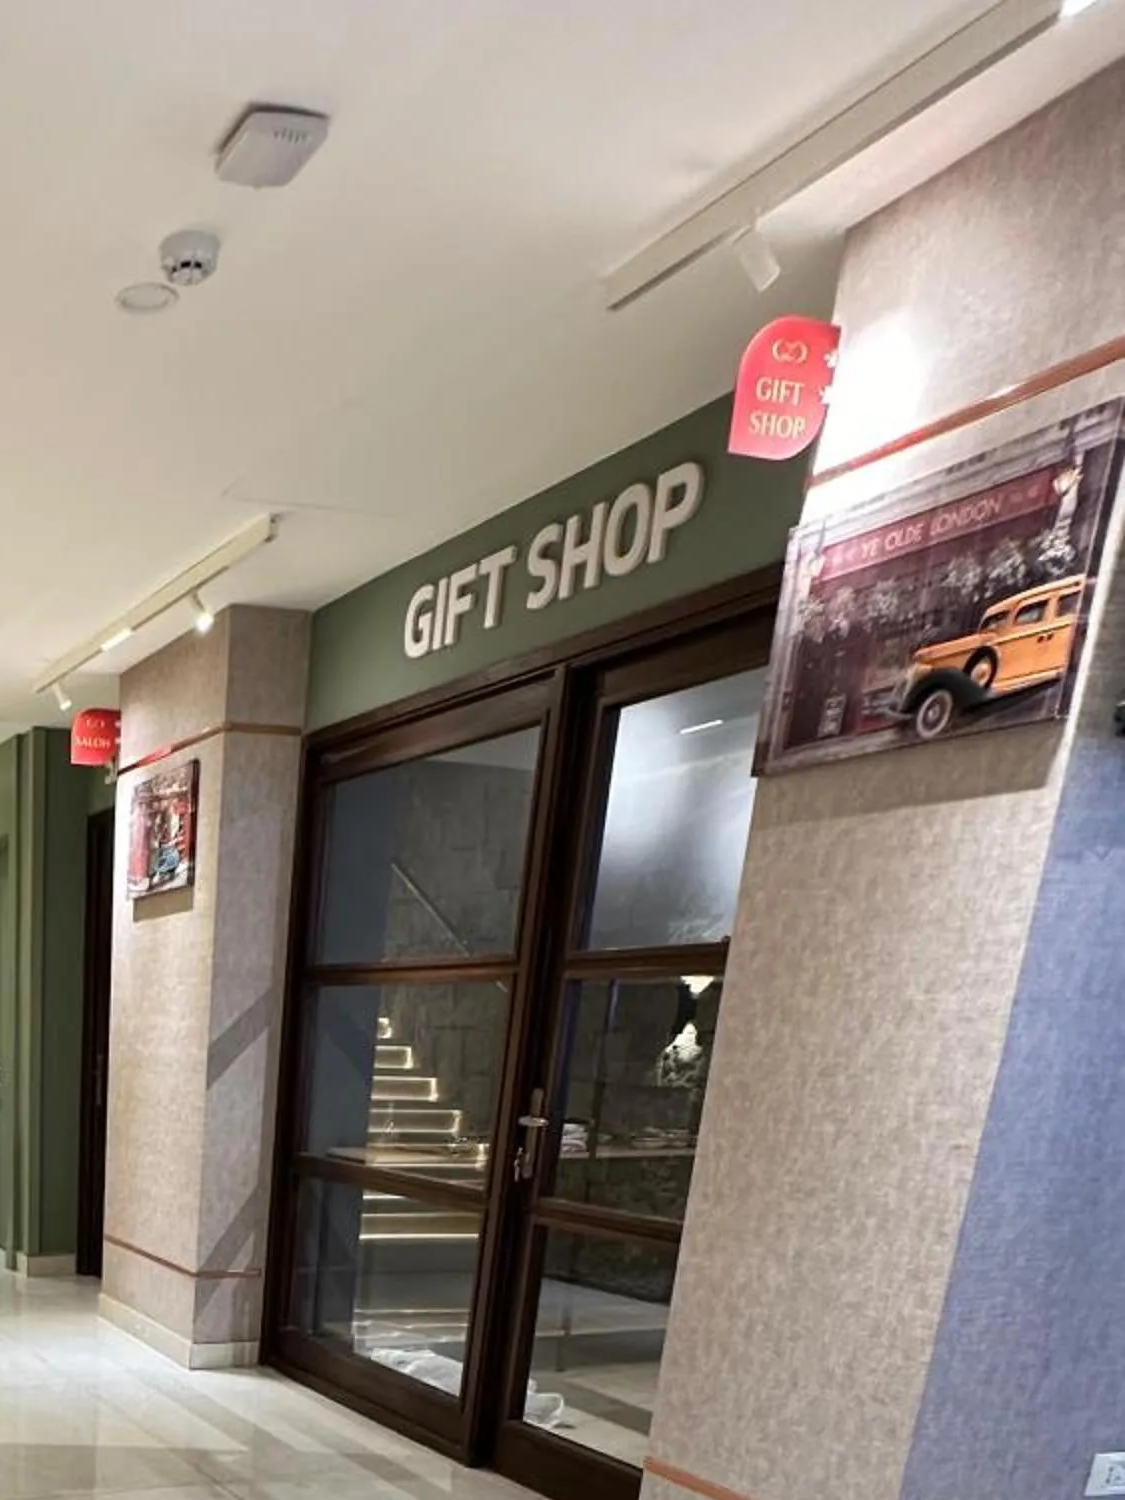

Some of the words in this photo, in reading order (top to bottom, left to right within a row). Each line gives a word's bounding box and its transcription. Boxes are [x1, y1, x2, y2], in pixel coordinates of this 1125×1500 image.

[756, 376, 804, 406] GIFT
[749, 410, 806, 439] SHOP
[884, 523, 925, 551] OLDE
[929, 495, 1003, 537] LONDON
[404, 545, 518, 659] GIFT
[526, 460, 705, 610] SHOP
